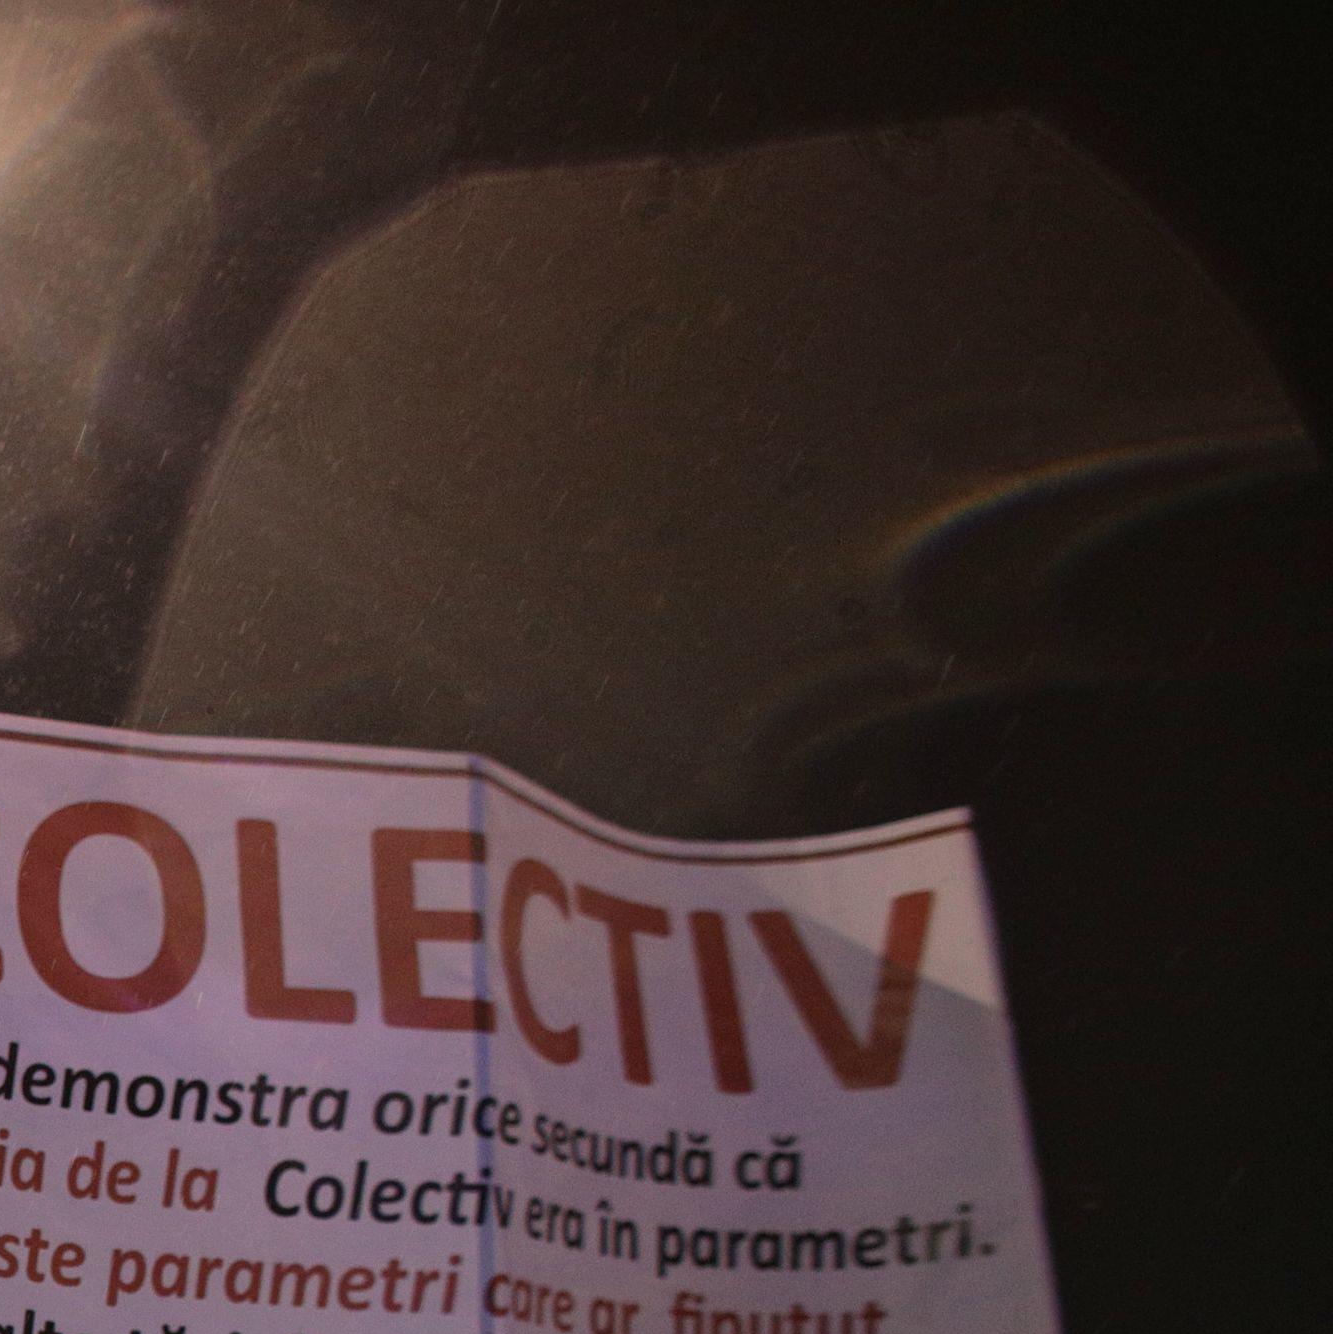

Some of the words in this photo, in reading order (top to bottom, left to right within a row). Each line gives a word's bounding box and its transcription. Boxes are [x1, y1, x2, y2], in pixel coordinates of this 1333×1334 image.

[372, 1079, 522, 1145] orice
[530, 1110, 714, 1188] secundă
[735, 1134, 802, 1191] că
[67, 1141, 141, 1204] de
[161, 1148, 219, 1212] la
[264, 1159, 514, 1229] Colectiv
[525, 1194, 584, 1250] era
[598, 1200, 637, 1261] în
[656, 1203, 997, 1278] parametri.
[106, 1249, 463, 1315] parametri
[483, 1270, 574, 1332] care
